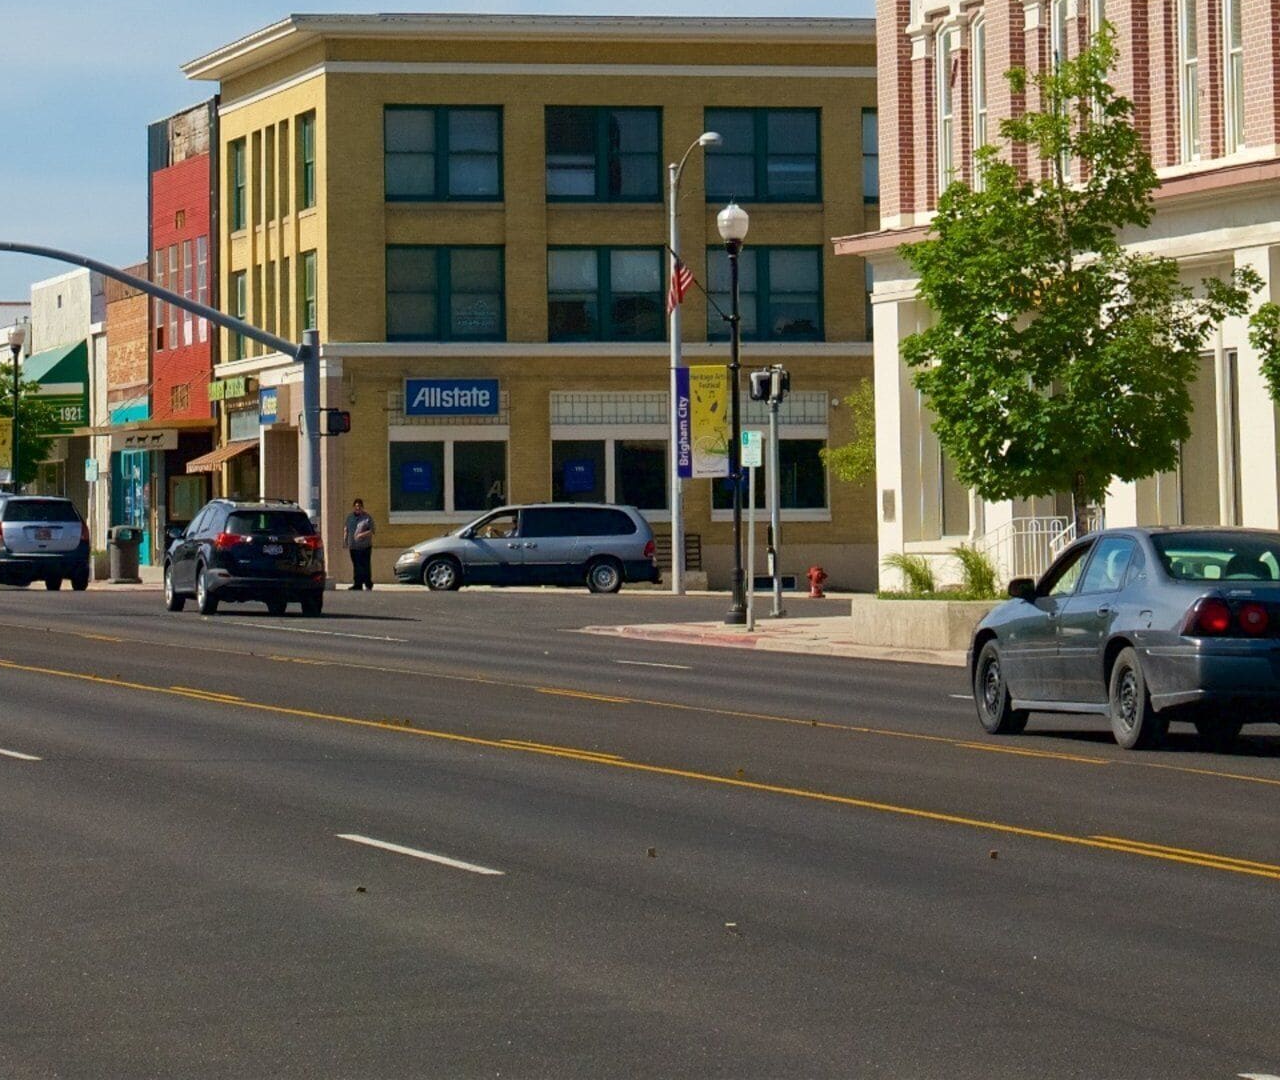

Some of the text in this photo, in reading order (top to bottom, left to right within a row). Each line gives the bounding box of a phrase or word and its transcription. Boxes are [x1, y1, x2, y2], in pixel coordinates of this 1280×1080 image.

[412, 387, 490, 408] Allstate
[60, 407, 82, 421] 1921
[678, 396, 690, 466] Brigham City
